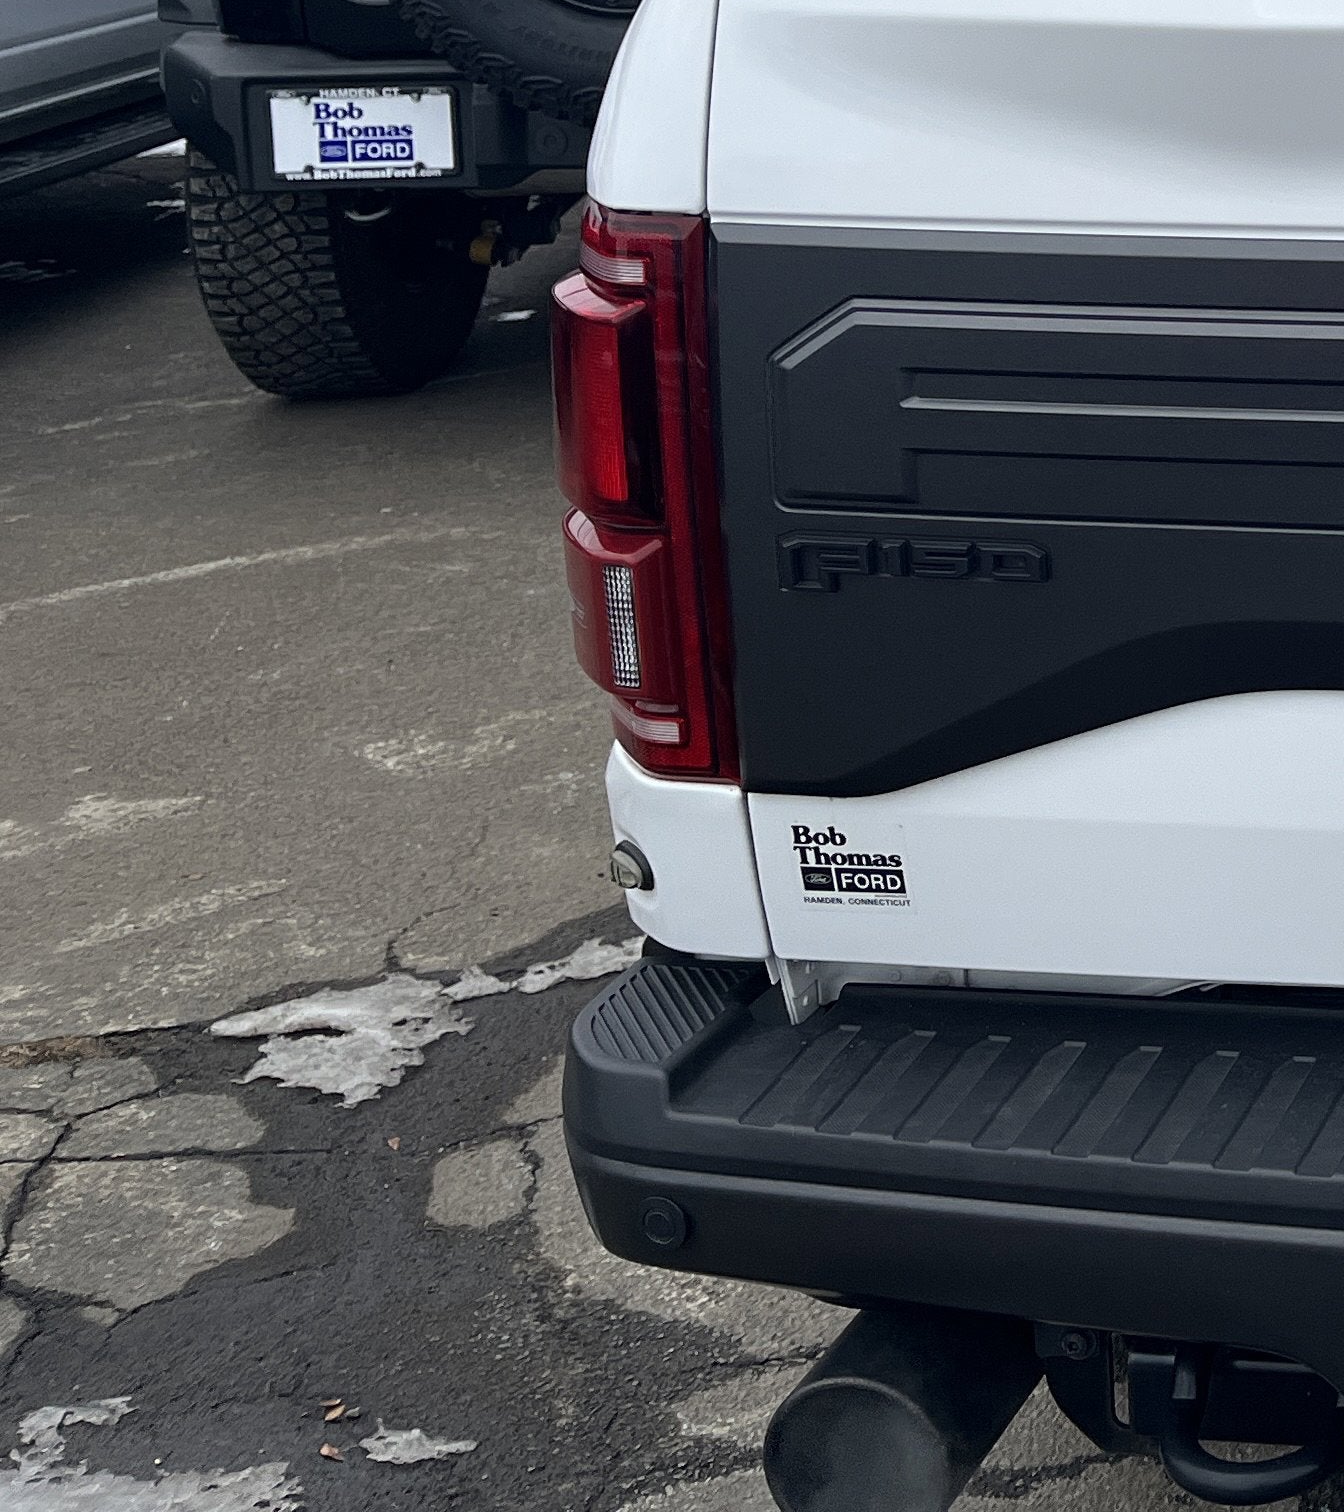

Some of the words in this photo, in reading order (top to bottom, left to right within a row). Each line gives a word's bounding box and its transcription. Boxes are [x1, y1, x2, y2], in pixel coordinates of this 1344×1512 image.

[314, 102, 363, 120] Bob
[313, 121, 413, 139] Thomas
[355, 142, 410, 159] FORD
[791, 825, 847, 846] Bob
[793, 846, 902, 867] Thomas
[841, 873, 901, 890] FORD
[848, 898, 911, 906] CONNECTICUT
